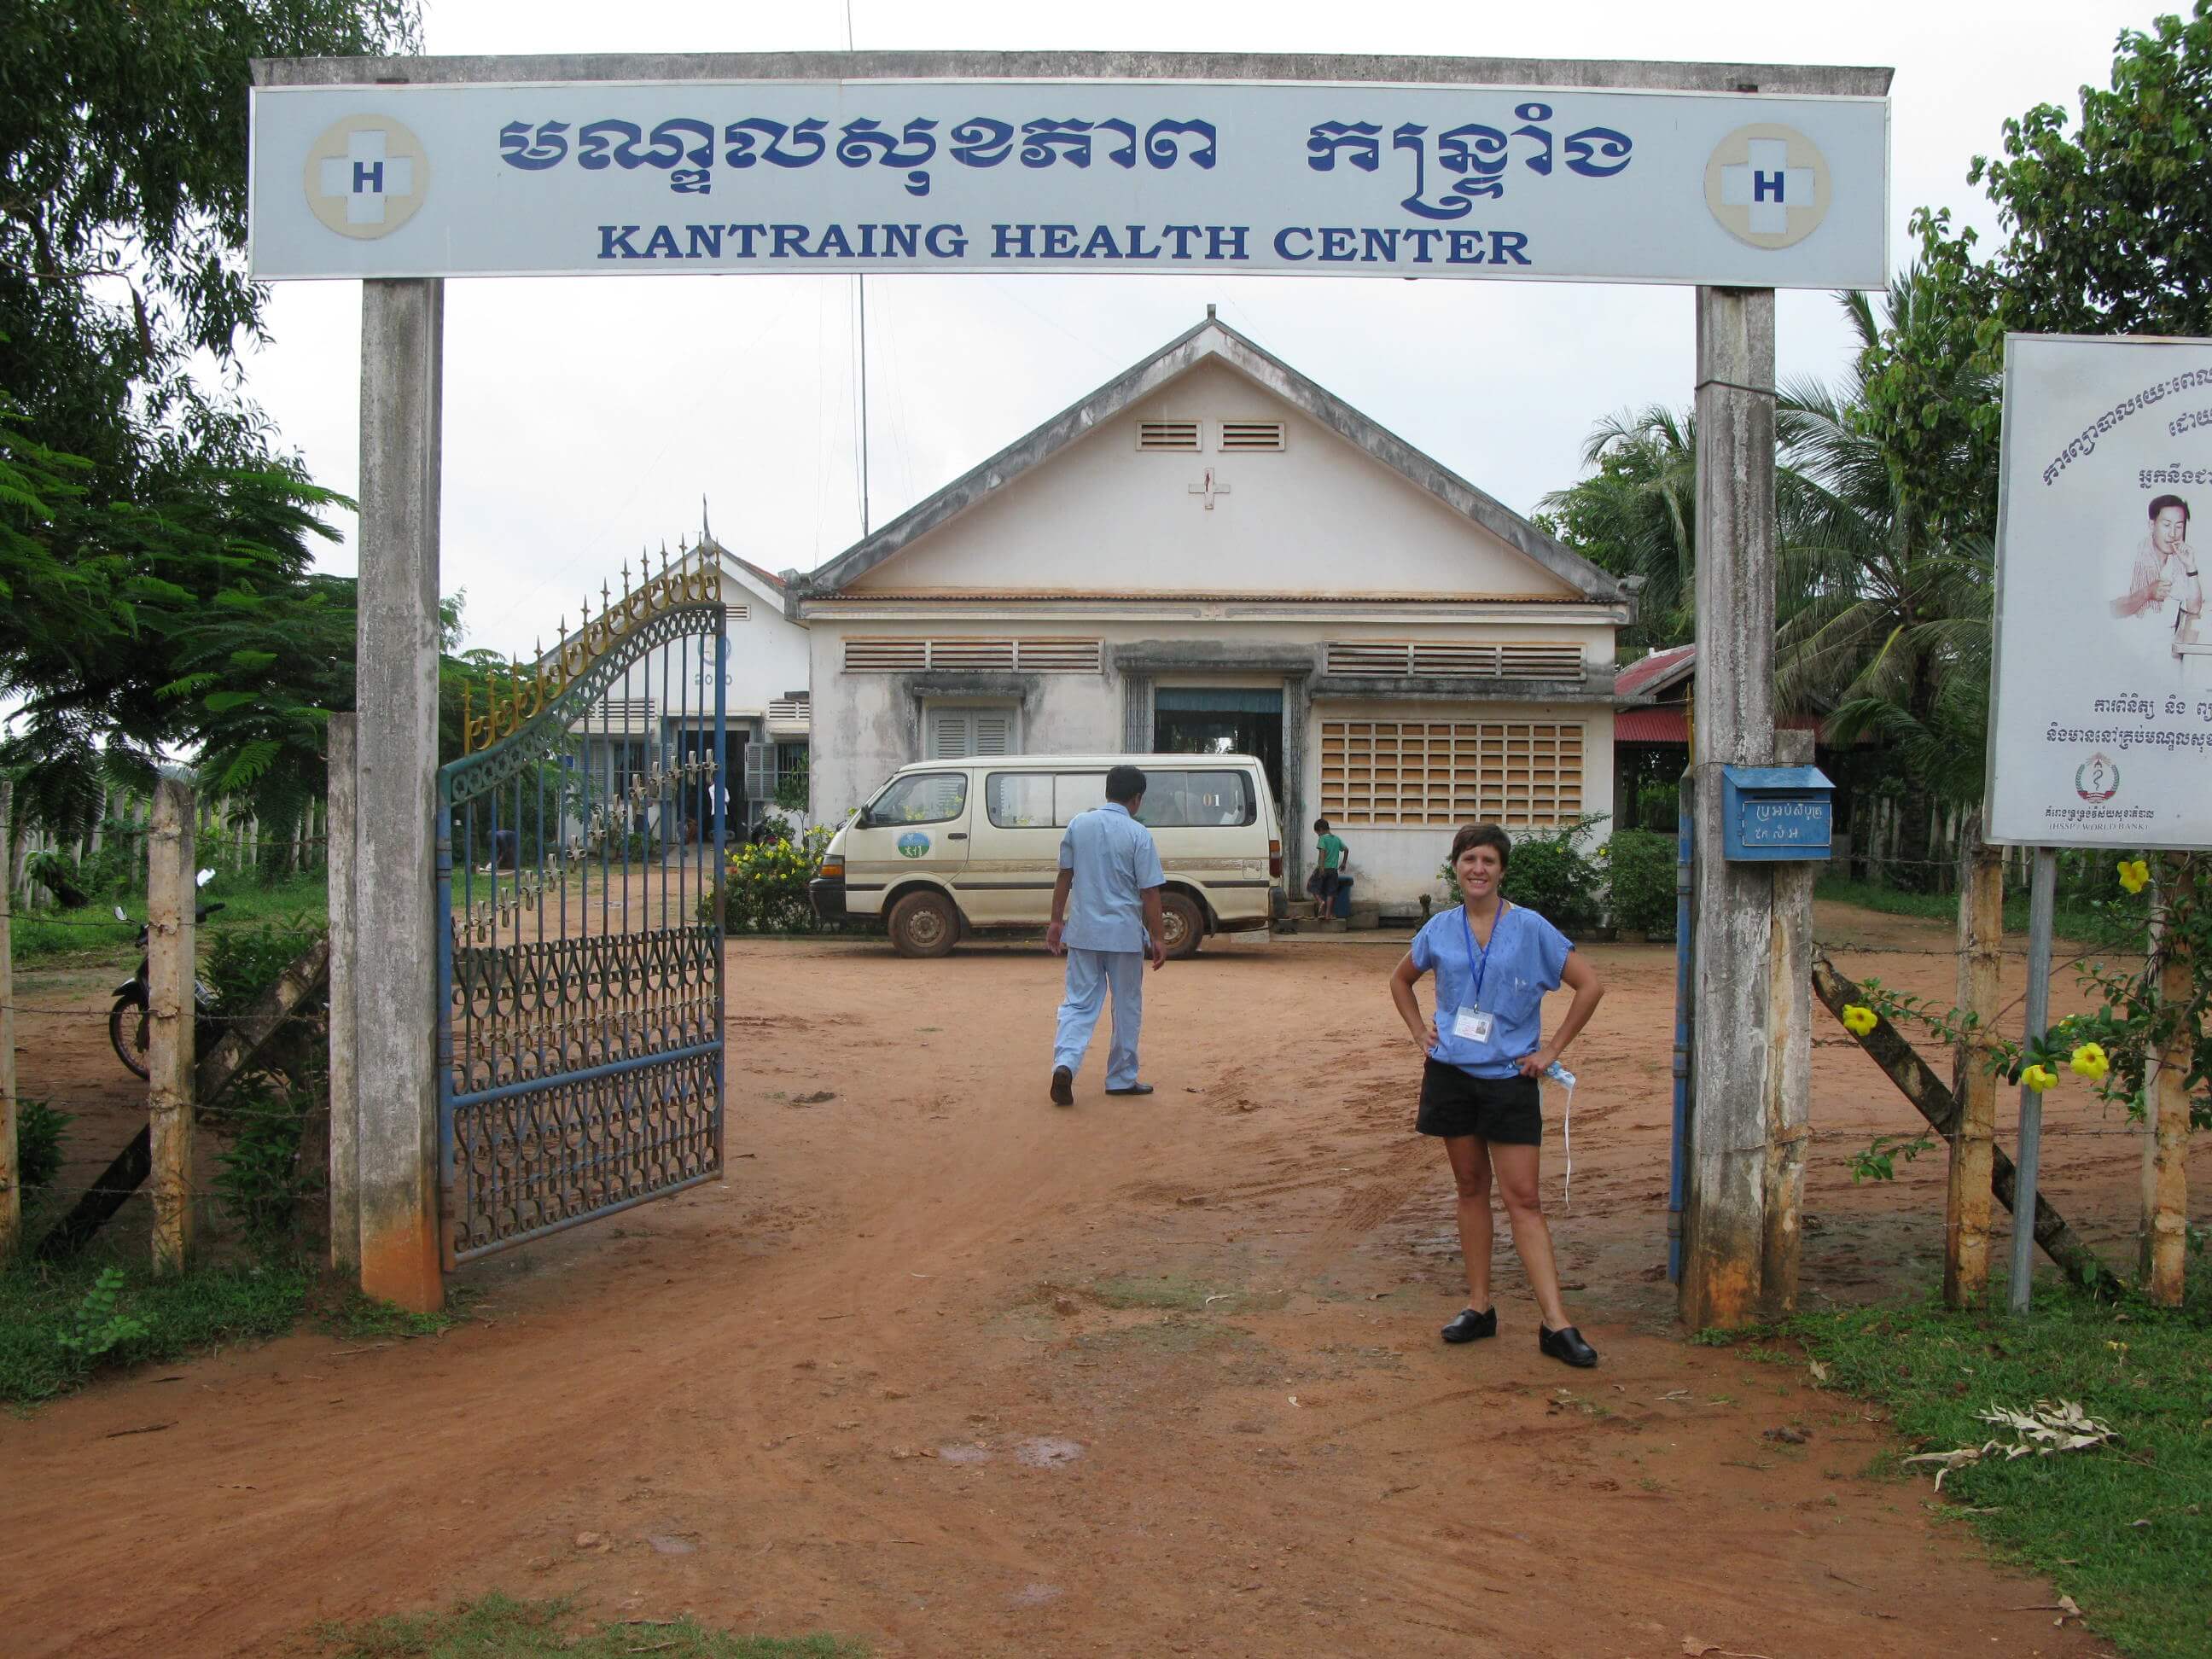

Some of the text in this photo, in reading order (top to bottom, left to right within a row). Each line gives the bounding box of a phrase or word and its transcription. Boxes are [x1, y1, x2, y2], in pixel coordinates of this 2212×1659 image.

[500, 116, 1217, 195] មណ្ឌលសុខភាព
[354, 161, 384, 192] H
[1754, 170, 1784, 203] H
[600, 224, 1530, 265] KANTRAING HEALTH CENTER
[1202, 792, 1221, 806] 01
